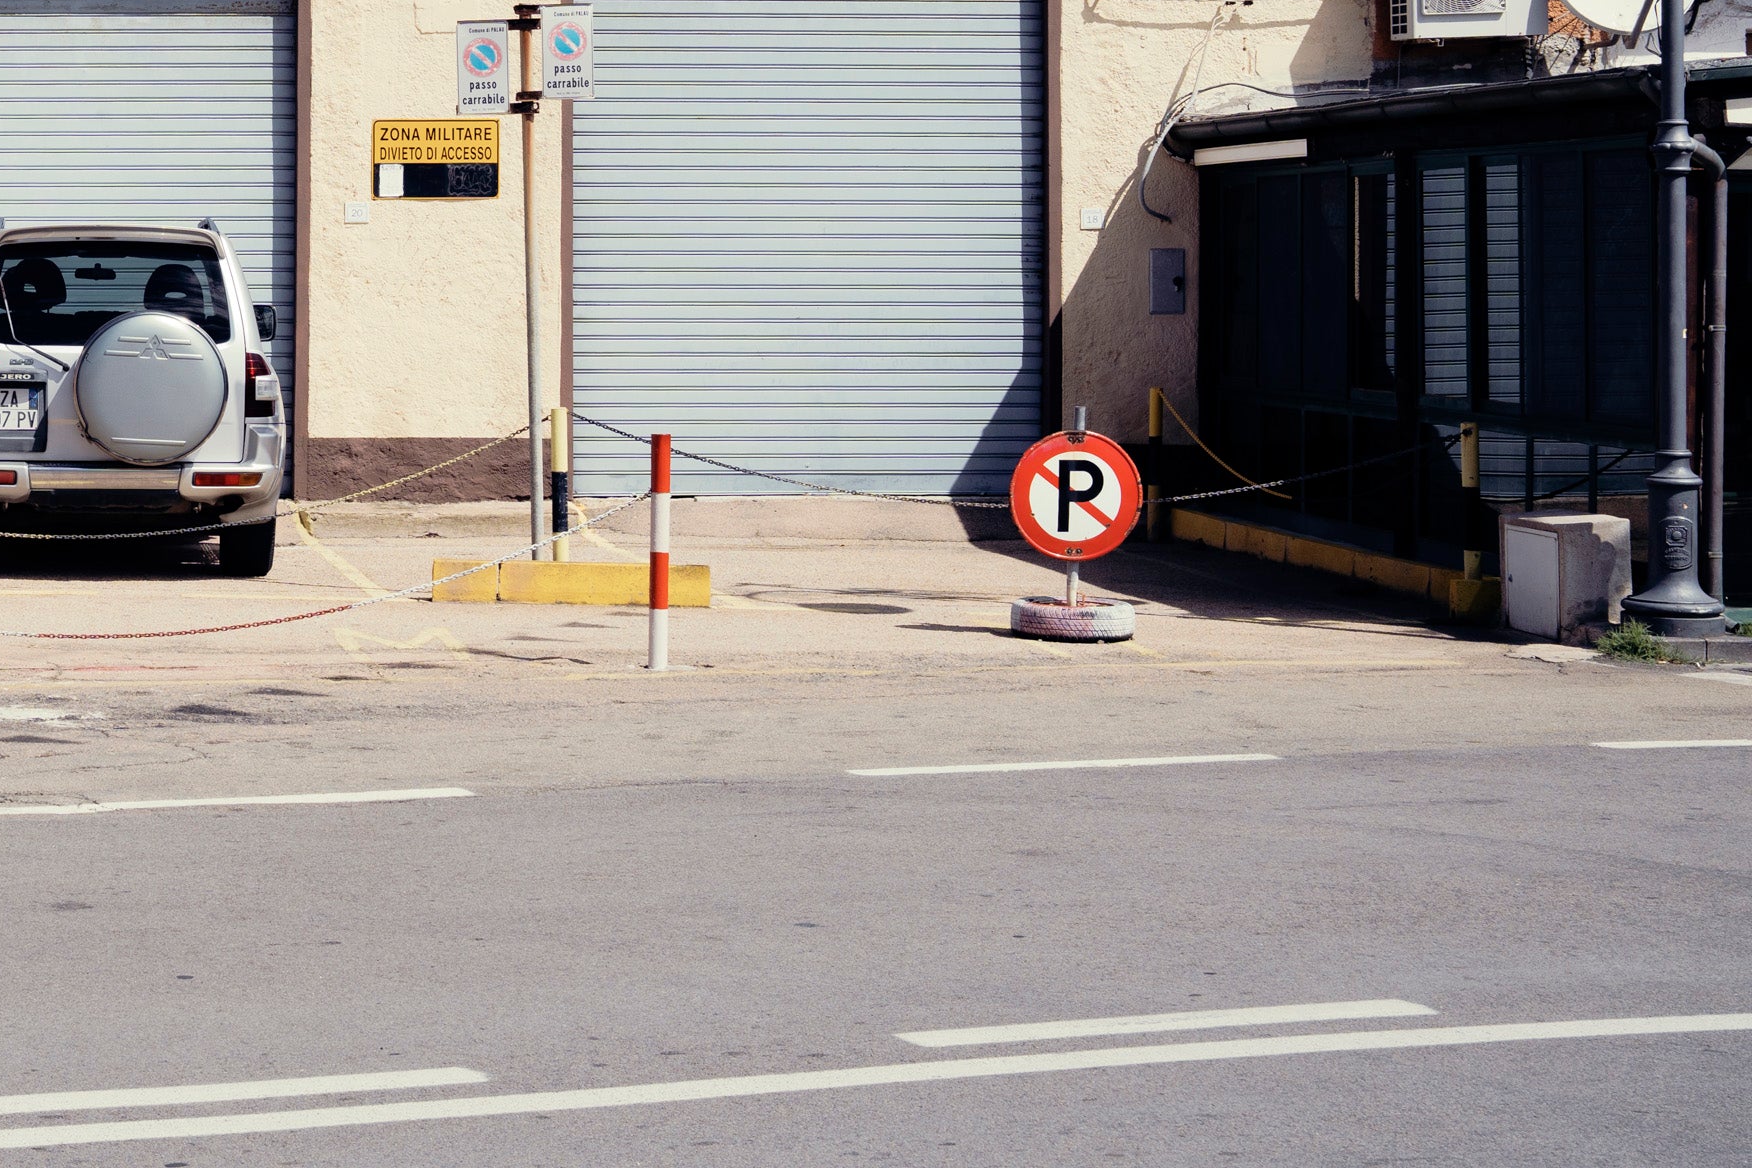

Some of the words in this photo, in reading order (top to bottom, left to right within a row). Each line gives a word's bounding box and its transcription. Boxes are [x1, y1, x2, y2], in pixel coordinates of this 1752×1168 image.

[554, 64, 582, 76] passo
[470, 80, 497, 92] passo
[547, 78, 590, 89] carrabile
[462, 94, 505, 105] carrabile
[380, 128, 420, 141] ZONA
[426, 128, 492, 141] MILITARE
[380, 147, 422, 160] DIVIETO
[427, 147, 437, 160] DI
[441, 147, 492, 160] ACCESSO
[351, 208, 363, 217] 20
[1087, 215, 1098, 223] 18
[0, 390, 18, 407] ZA
[17, 411, 36, 428] PV
[1057, 460, 1104, 532] P
